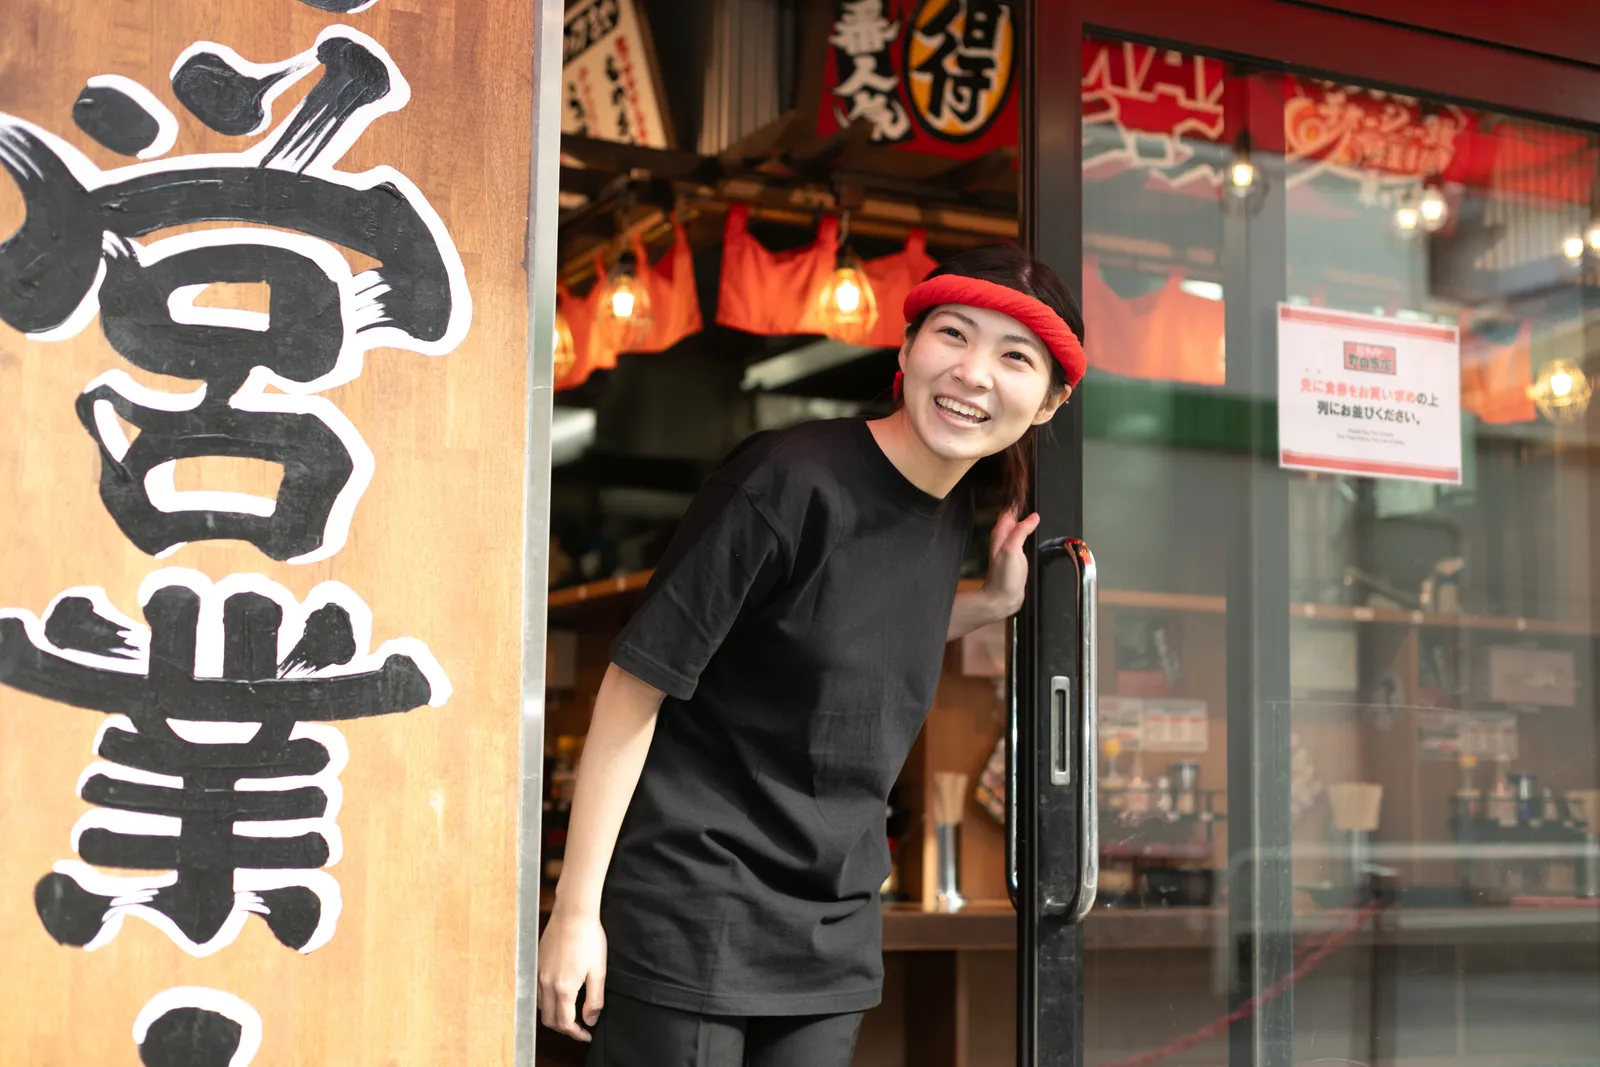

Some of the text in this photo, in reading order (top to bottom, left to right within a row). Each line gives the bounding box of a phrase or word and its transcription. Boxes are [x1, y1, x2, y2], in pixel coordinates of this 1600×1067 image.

[1301, 378, 1439, 407] 先に食券をお買い求めの上
[1317, 401, 1421, 425] 列にお並びください。
